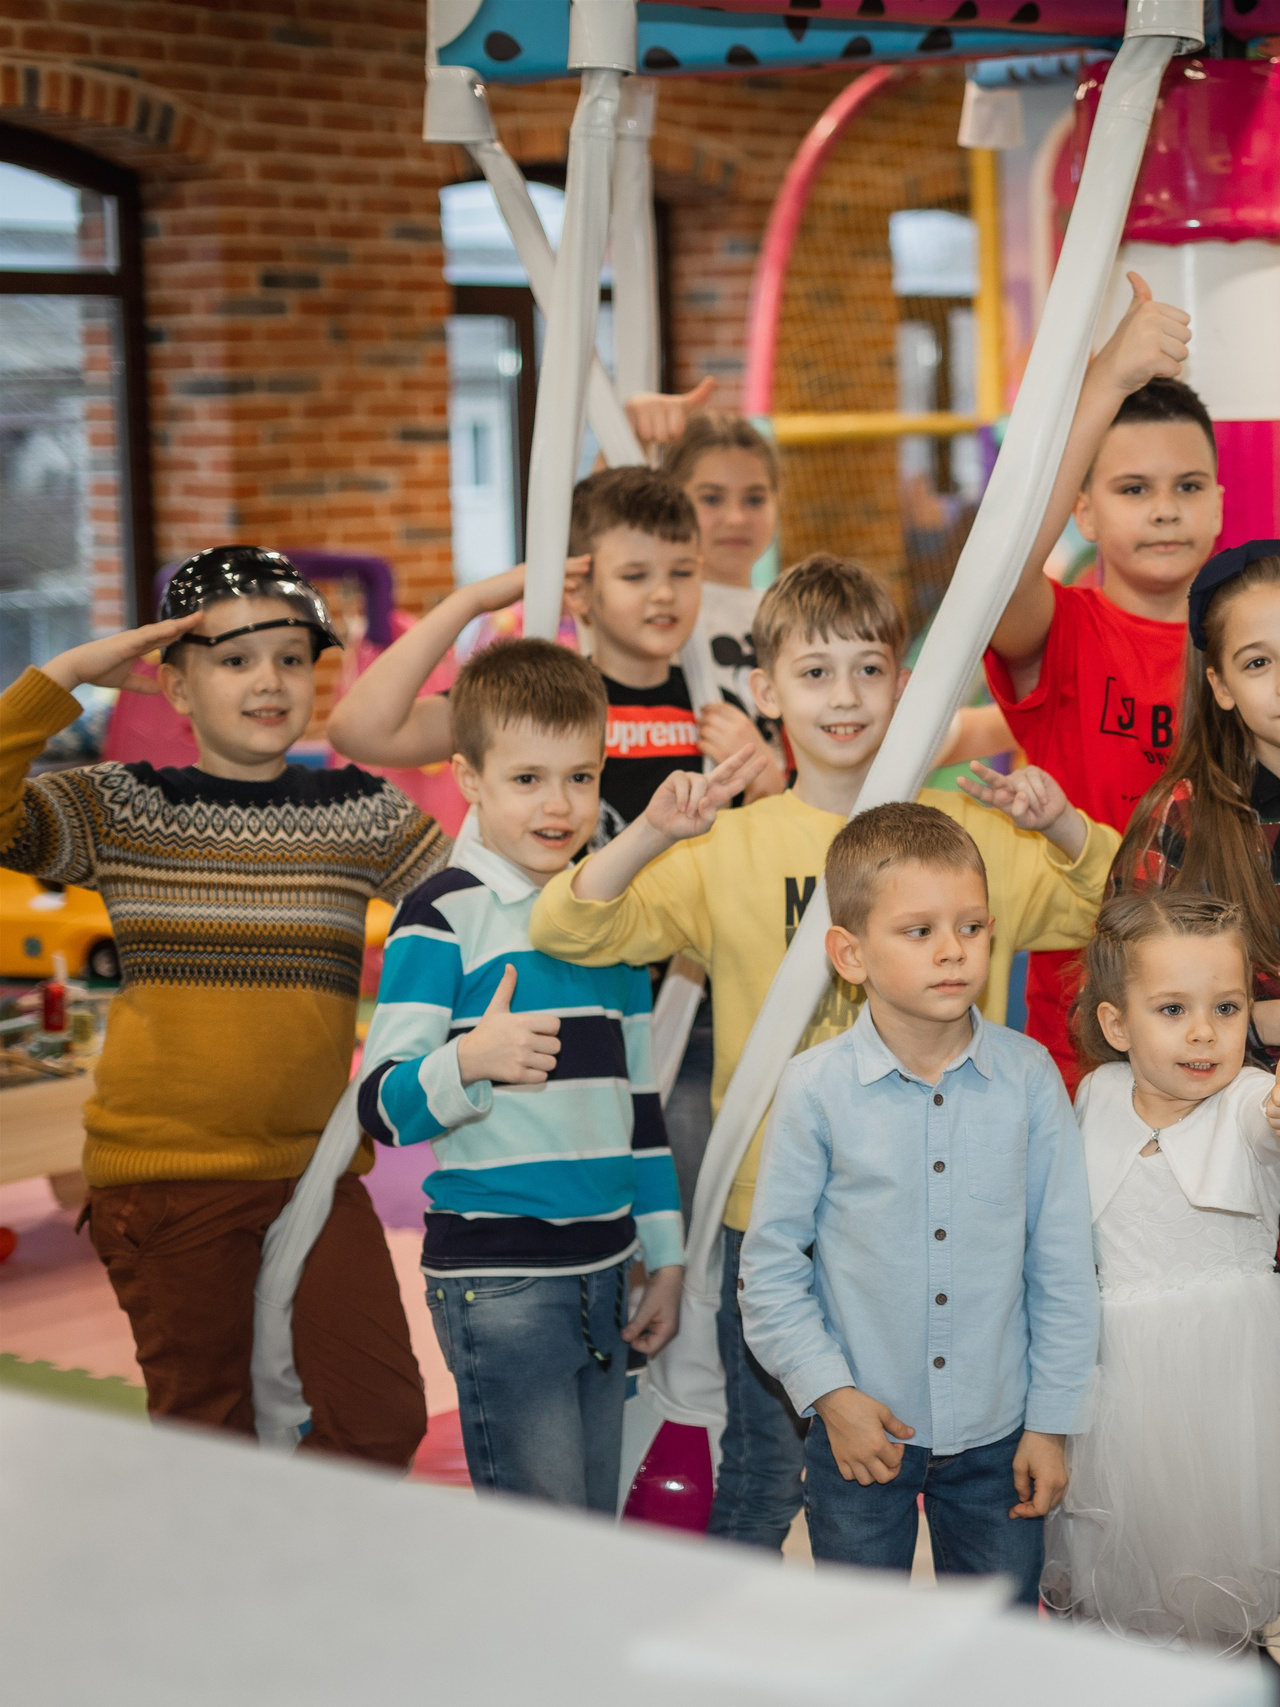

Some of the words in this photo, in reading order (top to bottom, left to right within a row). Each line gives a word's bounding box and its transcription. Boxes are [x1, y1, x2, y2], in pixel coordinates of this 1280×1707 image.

[606, 720, 698, 754] uprem
[1151, 705, 1173, 748] B
[785, 876, 816, 926] M
